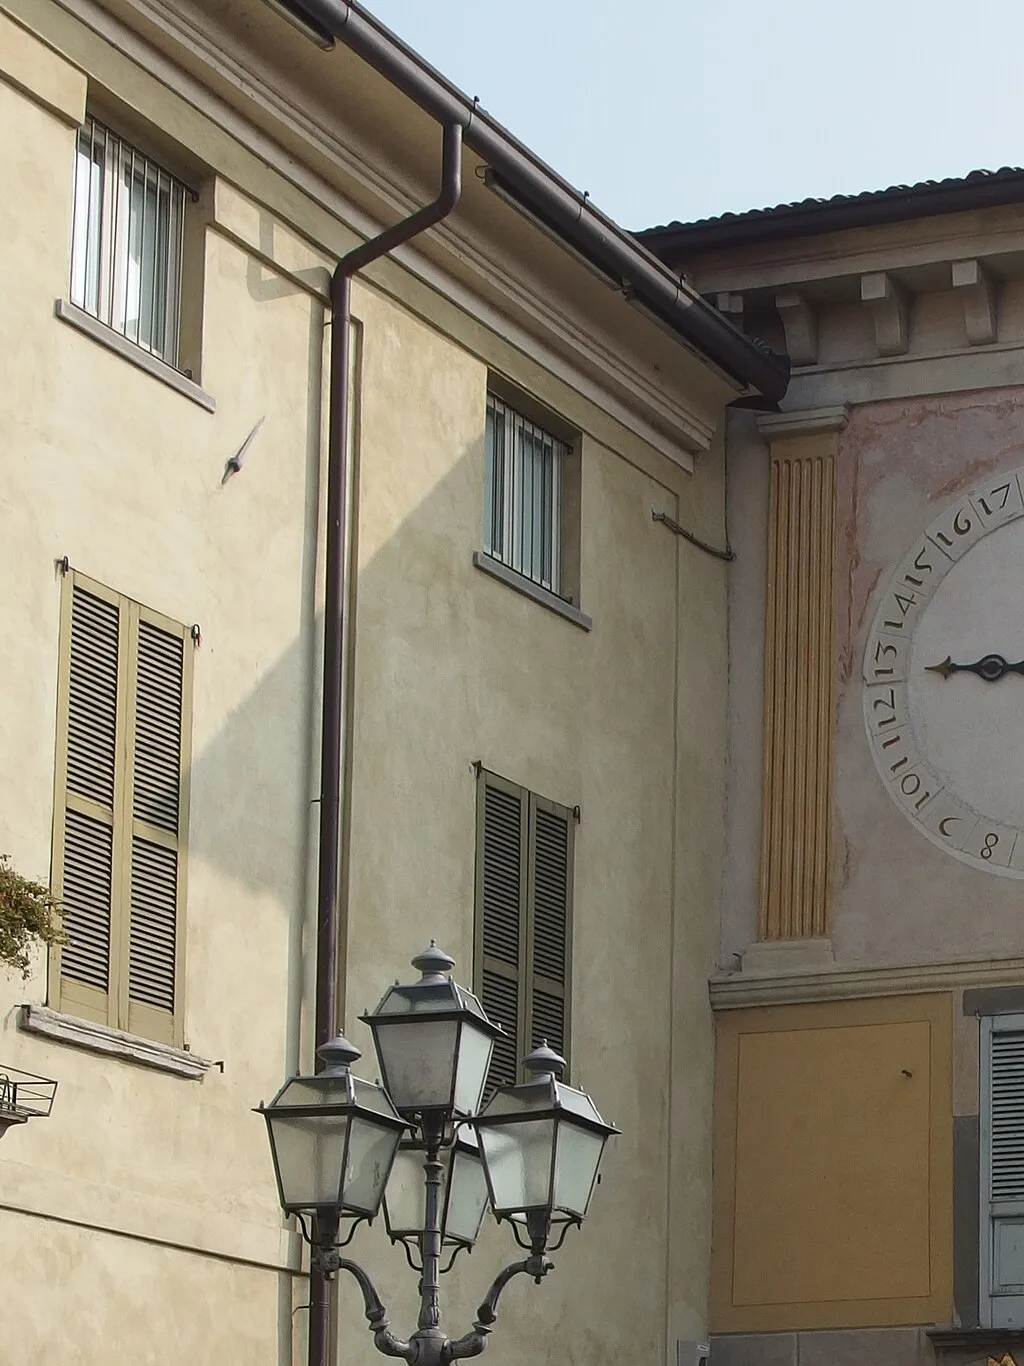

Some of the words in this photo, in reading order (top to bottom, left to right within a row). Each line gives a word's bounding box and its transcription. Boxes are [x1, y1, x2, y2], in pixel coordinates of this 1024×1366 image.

[978, 483, 1011, 515] 17
[935, 511, 970, 546] 16
[905, 549, 932, 587] 15
[883, 592, 917, 629] 14
[874, 640, 897, 676] 13
[873, 689, 896, 726] 12
[881, 734, 909, 772] 11
[900, 773, 931, 810] 10
[980, 833, 1000, 859] 8
